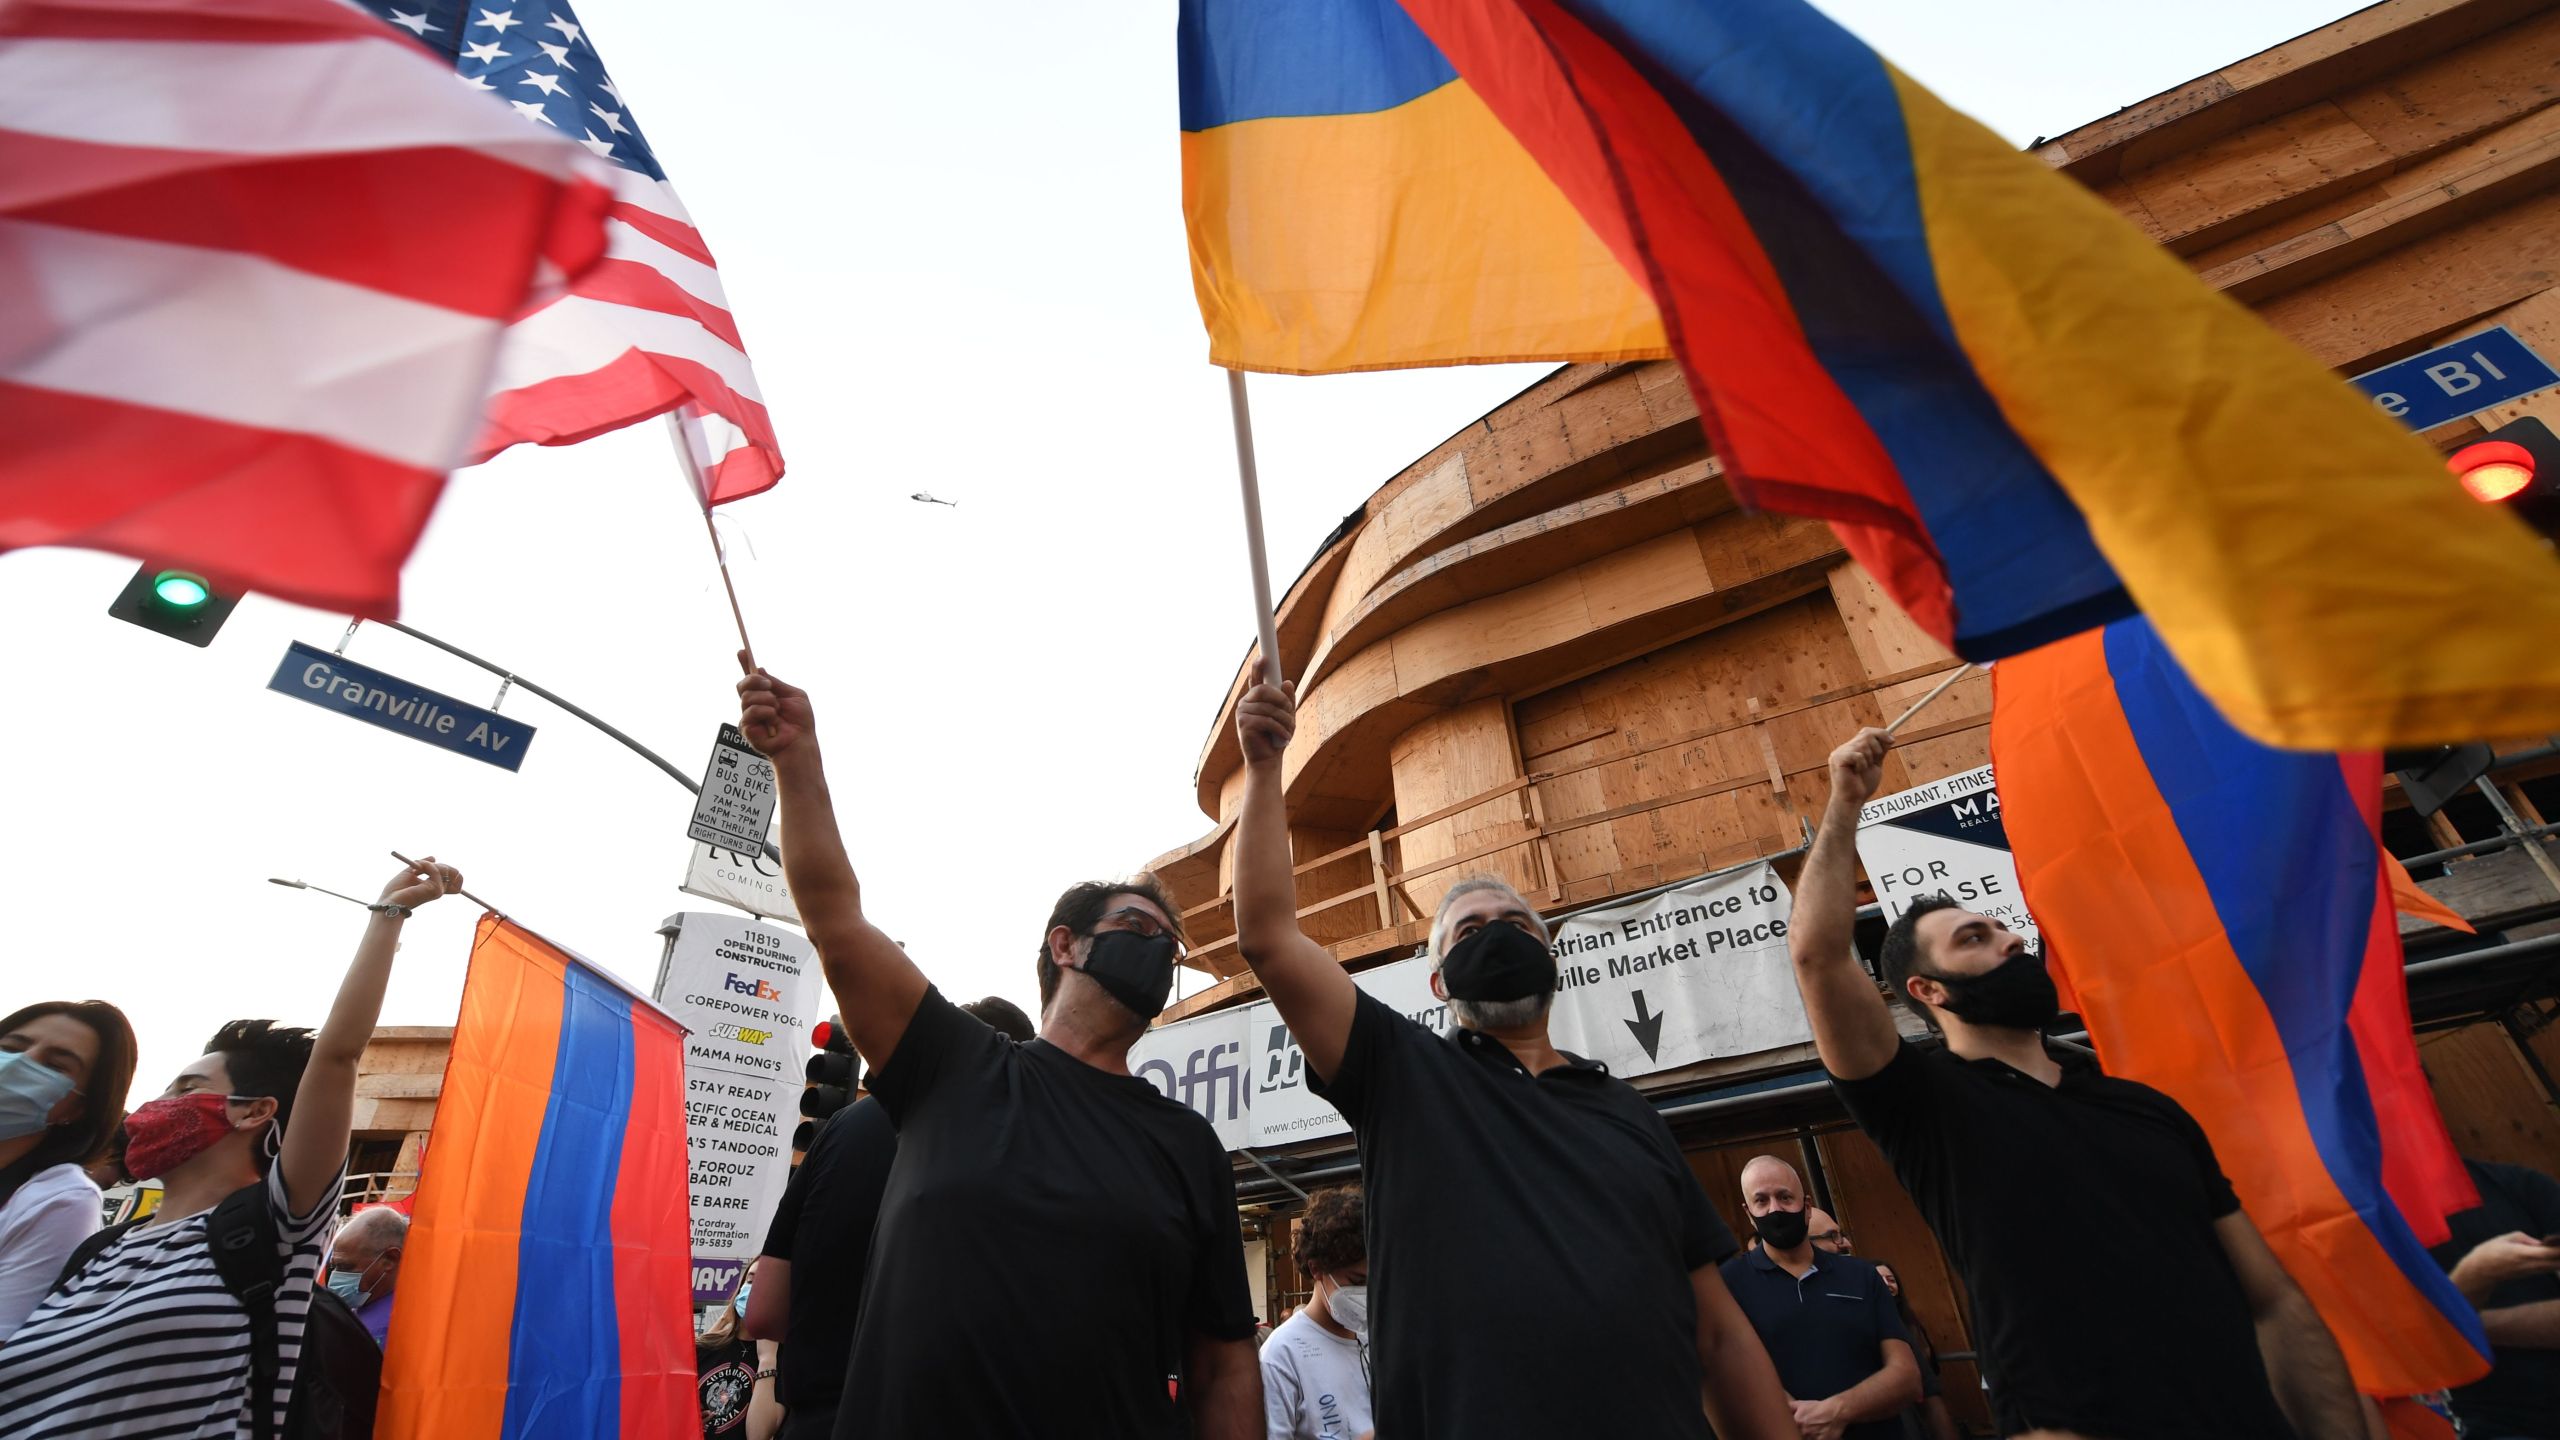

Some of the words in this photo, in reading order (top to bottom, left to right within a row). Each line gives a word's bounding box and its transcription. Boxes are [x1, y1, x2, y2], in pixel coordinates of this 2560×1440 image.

[302, 662, 456, 734] Granville
[465, 722, 511, 752] Av
[716, 767, 739, 783] BUS
[744, 777, 771, 795] BIKE
[723, 784, 758, 802] ONLY
[1858, 785, 1947, 824] RESTAURANT,
[696, 811, 717, 826] MON
[721, 819, 744, 834] THRU
[748, 828, 763, 841] FRI
[1959, 816, 1989, 829] REAL
[1991, 811, 2002, 821] E
[694, 827, 716, 841] RIGHT
[719, 835, 743, 850] TURNS
[746, 843, 757, 854] OK
[716, 868, 774, 893] COMING
[1880, 860, 1950, 893] FOR
[1620, 895, 1742, 943] Entrance
[1748, 884, 1778, 907] to
[723, 939, 754, 953] OPEN
[756, 947, 797, 964] DURING
[744, 930, 781, 949] 11819
[1607, 937, 1700, 979] Market
[1705, 918, 1788, 954] Place
[715, 948, 801, 977] CONSTRUCTION
[723, 972, 782, 1003] FedEx
[685, 994, 769, 1020] COREPOWER
[772, 1012, 804, 1029] YOGA
[709, 1022, 773, 1046] SUBWAY
[690, 1045, 731, 1062] MAMA
[734, 1053, 782, 1071] HONG'S
[689, 1079, 725, 1095] STAY
[727, 1085, 772, 1102] READY
[1135, 1041, 1250, 1124] Offi
[710, 1117, 720, 1129] &
[723, 1119, 779, 1136] MEDICAL
[731, 1107, 776, 1124] OCEAN
[711, 1139, 779, 1158] TANDOORI
[689, 1173, 732, 1188] BADRI
[698, 1160, 755, 1176] FOROUZ
[703, 1196, 750, 1210] BARRE
[694, 1229, 750, 1240] Information
[697, 1218, 736, 1230] Cordray
